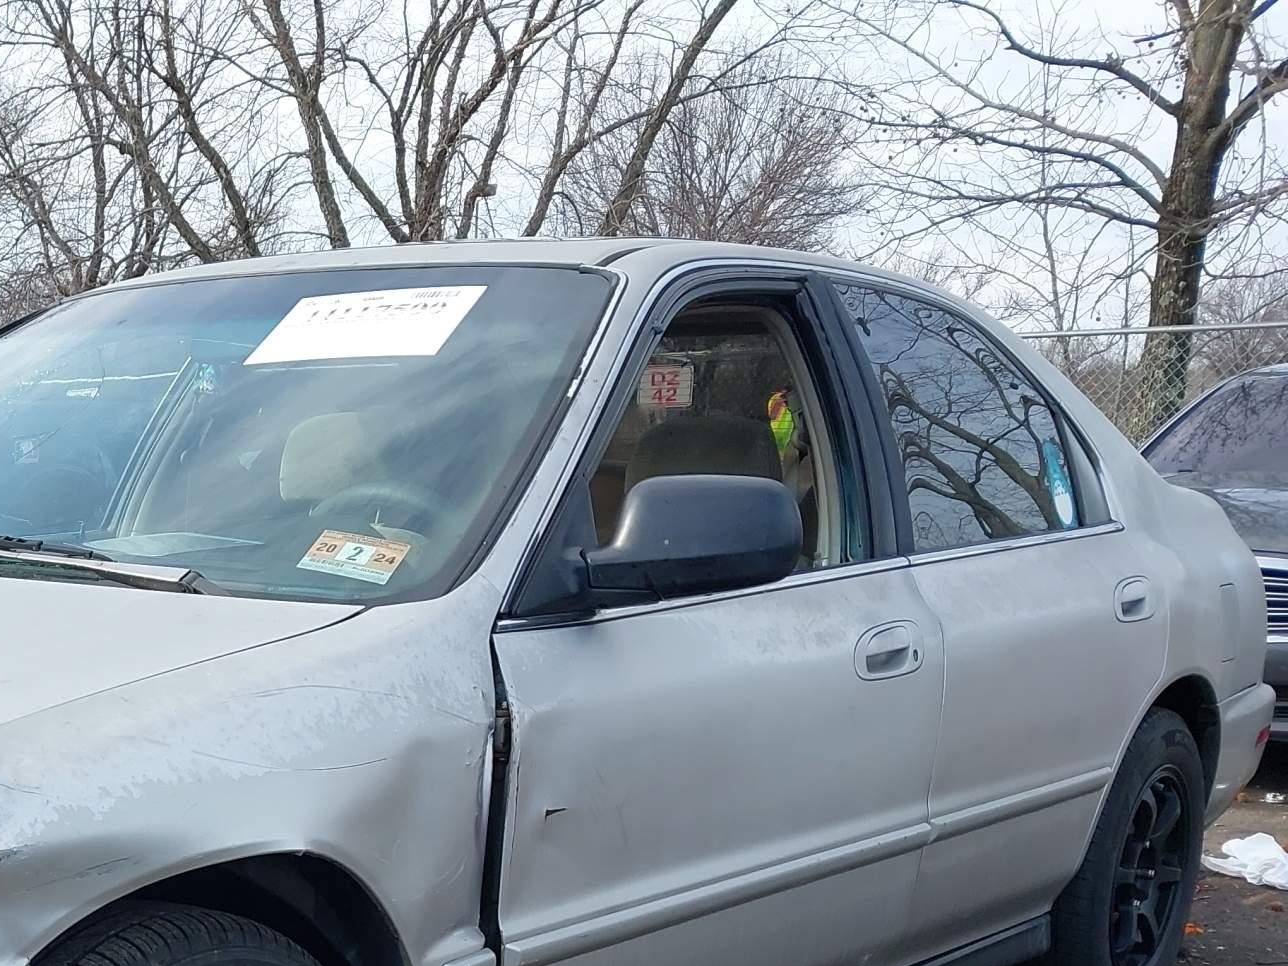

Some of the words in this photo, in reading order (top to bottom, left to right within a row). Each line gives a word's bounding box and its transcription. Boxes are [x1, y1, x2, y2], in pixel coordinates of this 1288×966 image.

[651, 387, 677, 401] 42
[316, 542, 337, 553] 20
[346, 546, 364, 561] 2
[373, 553, 396, 565] 24
